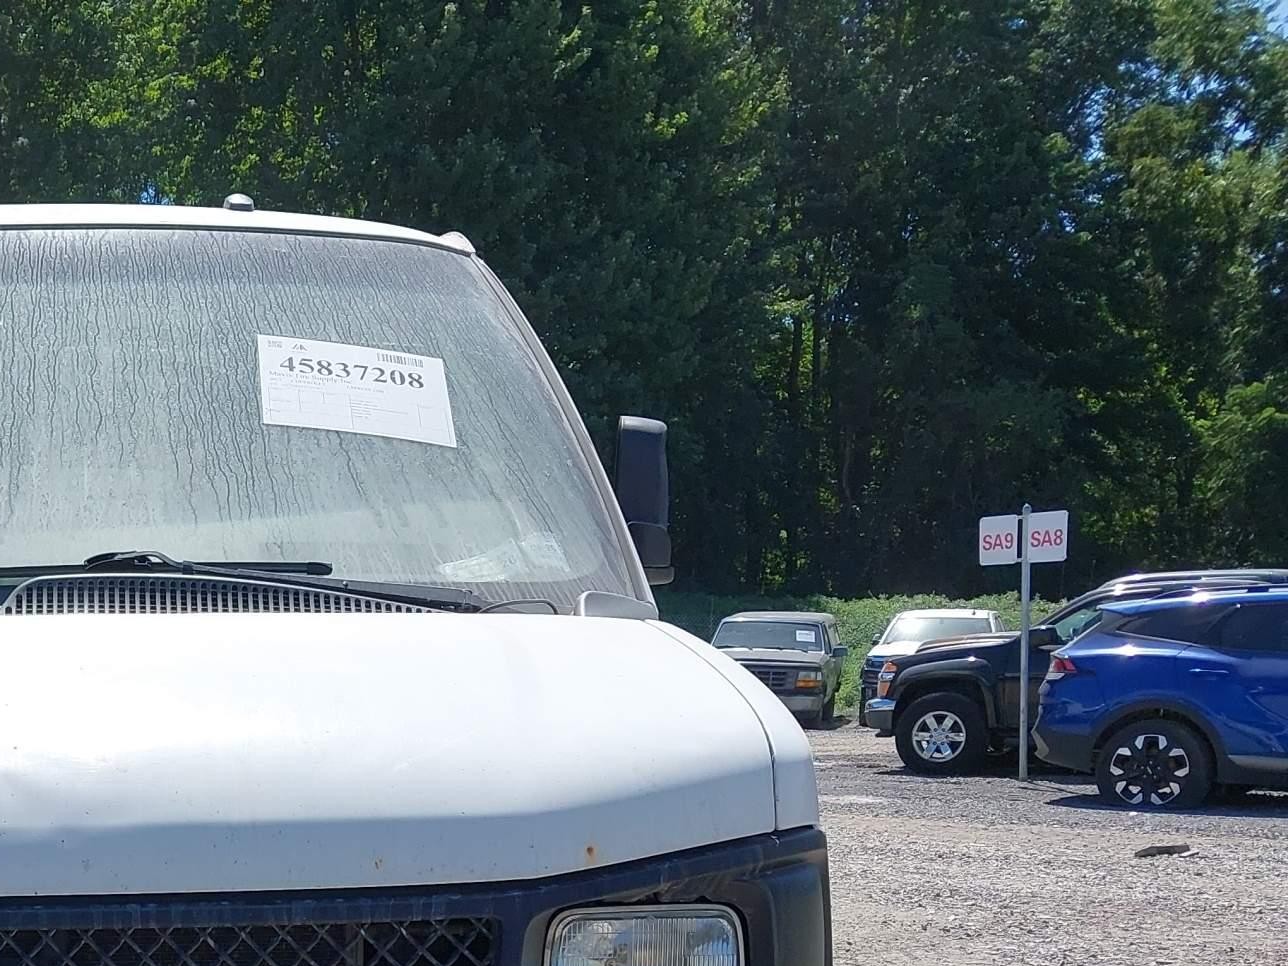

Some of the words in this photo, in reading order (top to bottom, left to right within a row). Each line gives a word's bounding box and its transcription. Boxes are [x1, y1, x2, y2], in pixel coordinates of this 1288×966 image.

[279, 356, 425, 389] 45837208
[982, 532, 1014, 551] SA9
[1031, 529, 1063, 547] SA8
